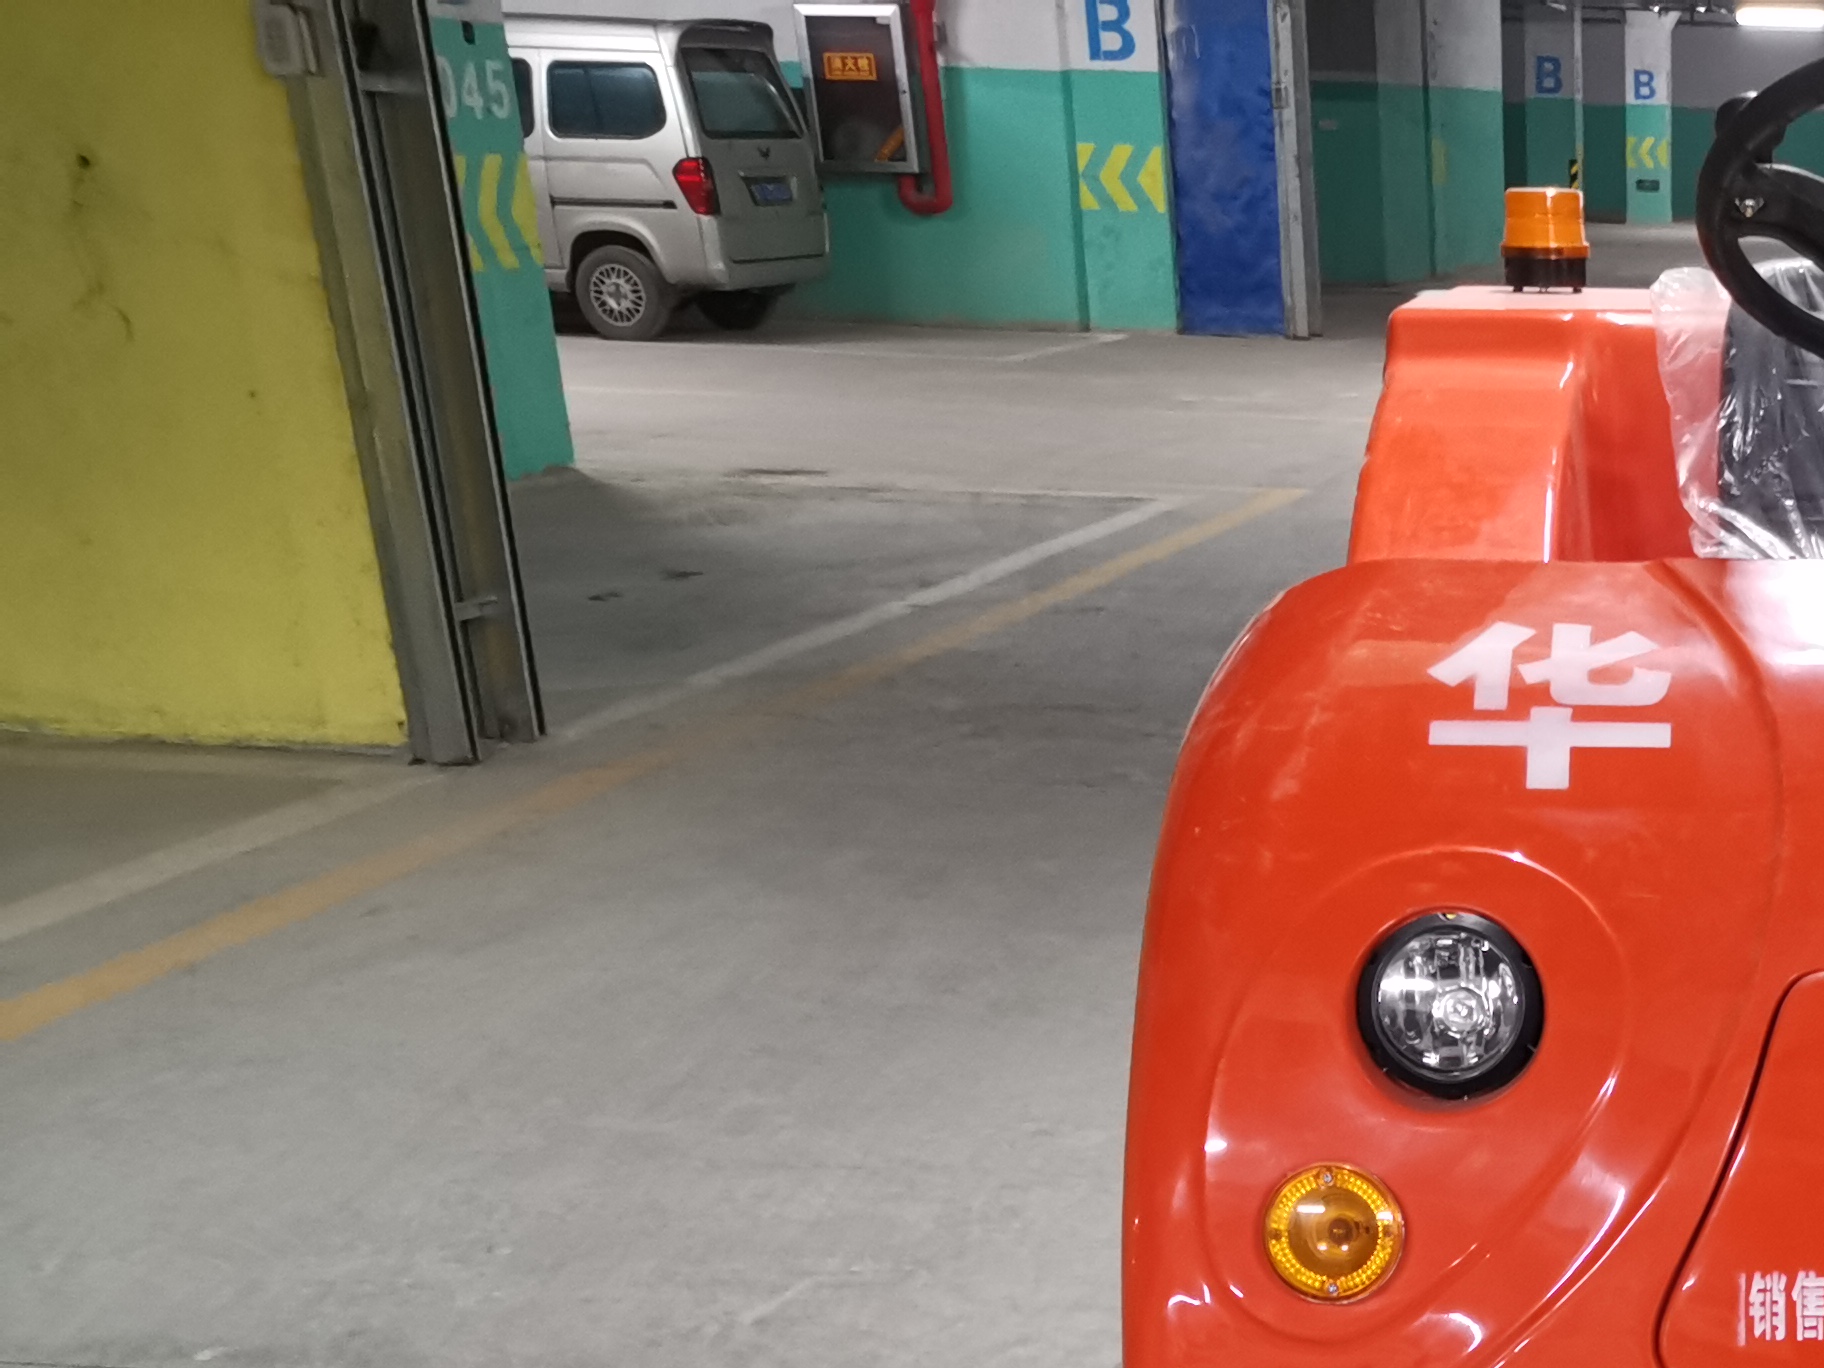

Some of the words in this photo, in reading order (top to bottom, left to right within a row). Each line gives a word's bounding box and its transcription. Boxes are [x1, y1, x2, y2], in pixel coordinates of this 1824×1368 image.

[1085, 0, 1135, 61] B
[1536, 55, 1562, 94] B
[1634, 69, 1655, 100] B
[1427, 621, 1672, 790] 华
